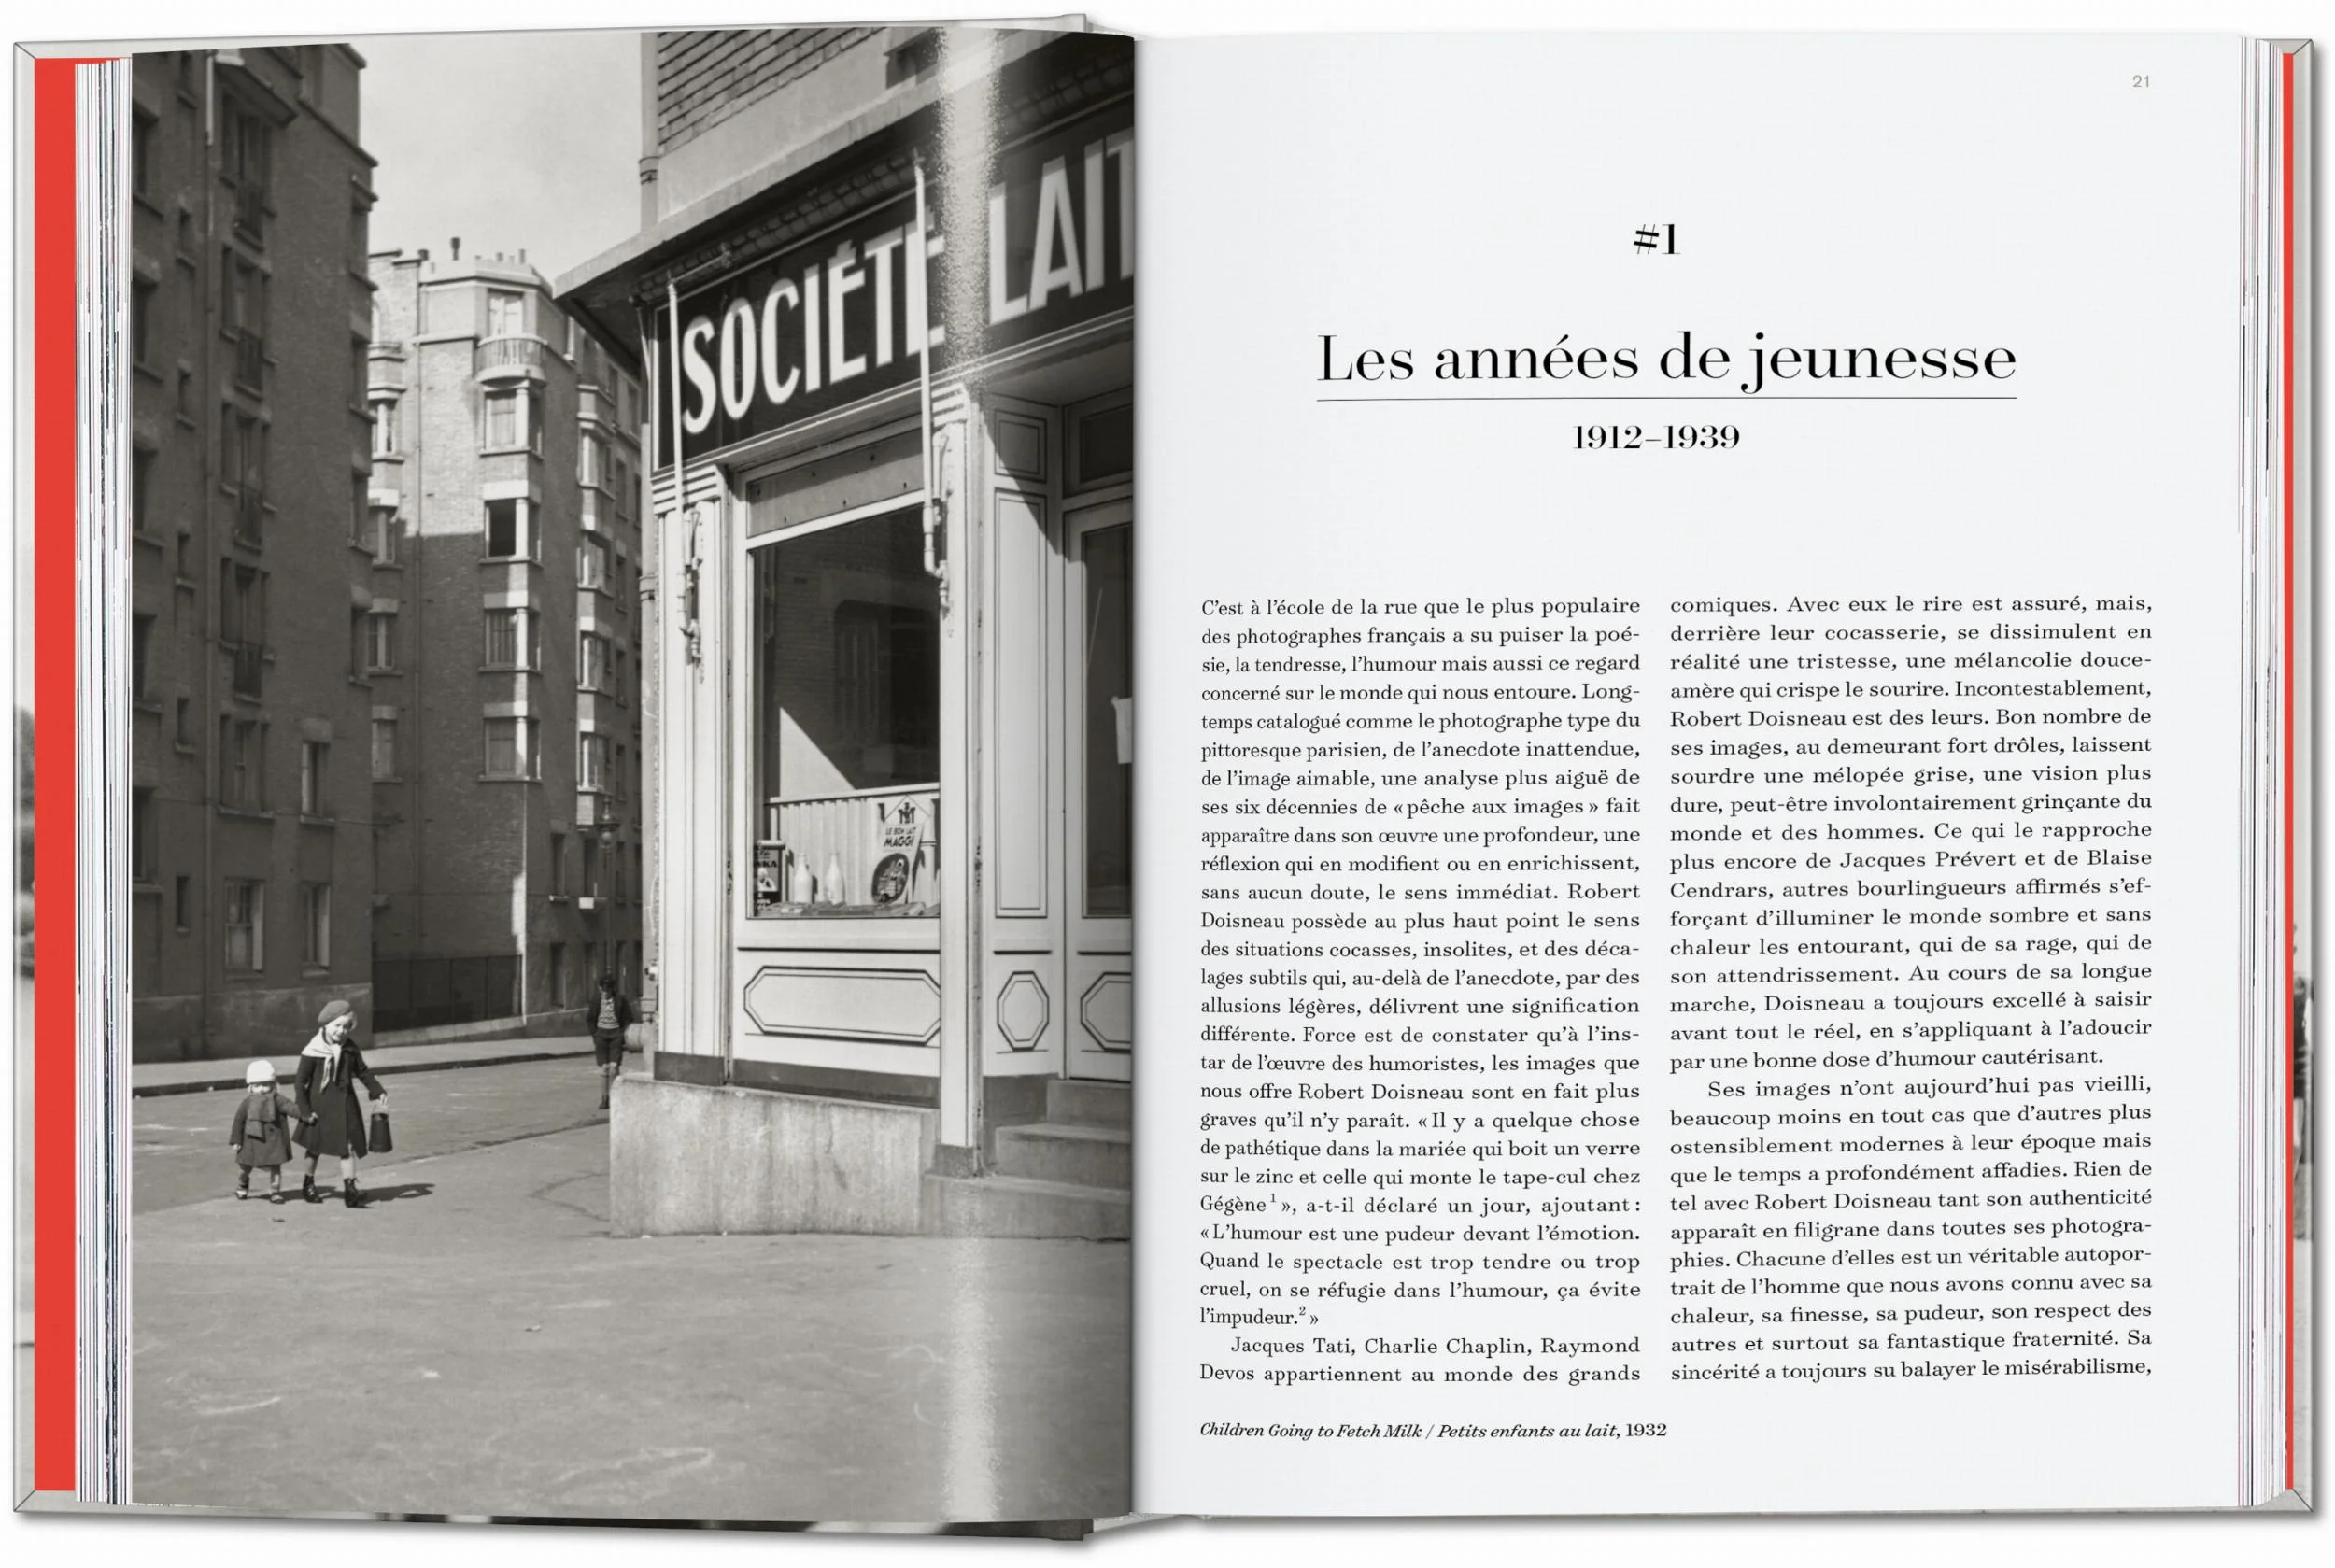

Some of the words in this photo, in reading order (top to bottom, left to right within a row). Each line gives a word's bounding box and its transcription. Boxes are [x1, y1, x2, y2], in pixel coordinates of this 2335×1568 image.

[2132, 74, 2150, 88] 21
[1633, 223, 1681, 255] #1
[682, 208, 947, 434] SOCIÉTÉ
[1316, 334, 1414, 381] Les
[1435, 333, 1639, 380] années
[1659, 330, 1731, 380] de
[1740, 332, 2017, 395] jeunesse
[1201, 600, 1244, 616] C’est
[1251, 599, 1261, 615] à
[1267, 598, 1325, 615] l’école
[1331, 598, 1354, 615] de
[1360, 598, 1379, 614] la
[1384, 602, 1418, 614] rue
[1423, 602, 1460, 619] que
[1465, 597, 1485, 614] le
[1491, 597, 1534, 619] plus
[1541, 596, 1641, 619] populaire
[1670, 596, 1778, 617] comiques.
[1786, 595, 1840, 613] Avec
[1848, 600, 1888, 612] eux
[1895, 595, 1915, 612] le
[1922, 595, 1963, 612] rire
[1972, 597, 2003, 612] est
[2011, 594, 2087, 614] assuré,
[2095, 594, 2152, 614] mais,
[1201, 685, 1281, 701] concerné
[1285, 689, 1315, 701] sur
[1318, 684, 1336, 701] le
[1339, 683, 1404, 700] monde
[1408, 684, 1437, 705] qui
[1442, 688, 1489, 700] nous
[1493, 685, 1577, 700] entoure.
[1581, 683, 1640, 704] Long-
[1670, 682, 1734, 699] amère
[1739, 681, 1772, 703] qui
[1776, 681, 1840, 703] crispe
[1845, 680, 1864, 698] le
[1869, 680, 1949, 698] sourire.
[1955, 679, 2152, 699] Incontestablement,
[1670, 767, 1755, 784] sourdre
[1763, 771, 1804, 784] une
[1812, 766, 1904, 788] mélopée
[1913, 765, 1974, 787] grise,
[1982, 770, 2023, 782] une
[2031, 764, 2099, 782] vision
[2106, 763, 2152, 786] plus
[884, 836, 914, 847] MAGGI
[1670, 824, 1742, 841] monde
[1751, 826, 1773, 841] et
[1781, 823, 1818, 841] des
[1826, 823, 1925, 840] hommes.
[1934, 822, 1962, 839] Ce
[1971, 822, 2005, 843] qui
[2014, 821, 2033, 838] le
[2042, 820, 2152, 842] rapproche
[1200, 855, 1281, 872] réflexion
[1284, 855, 1314, 877] qui
[1319, 860, 1343, 872] en
[1348, 855, 1441, 872] modifient
[1447, 859, 1472, 872] ou
[1477, 859, 1502, 871] en
[1507, 854, 1640, 873] enrichissent,
[1200, 911, 1285, 929] Doisneau
[1291, 911, 1367, 934] possède
[1374, 917, 1397, 929] au
[1404, 911, 1445, 934] plus
[1452, 911, 1499, 929] haut
[1506, 911, 1560, 934] point
[1567, 911, 1586, 928] le
[1593, 916, 1640, 928] sens
[1670, 910, 1748, 931] forçant
[1756, 909, 1875, 926] d’illuminer
[1882, 908, 1902, 925] le
[1909, 907, 1982, 925] monde
[1989, 906, 2069, 924] sombre
[2076, 908, 2098, 923] et
[2106, 910, 2152, 922] sans
[1200, 996, 1281, 1014] allusions
[1288, 997, 1362, 1020] légères,
[1368, 997, 1460, 1015] délivrent
[1465, 1002, 1504, 1014] une
[1511, 996, 1640, 1019] signification
[1669, 995, 1756, 1014] marche,
[1763, 995, 1865, 1011] Doisneau
[1873, 998, 1886, 1010] a
[1893, 993, 1984, 1014] toujours
[1992, 991, 2067, 1009] excellé
[2073, 991, 2087, 1008] à
[2094, 990, 2153, 1007] saisir
[1200, 1086, 1243, 1099] nous
[1249, 1082, 1293, 1099] offre
[1298, 1082, 1365, 1100] Robert
[1371, 1083, 1465, 1100] Doisneau
[1471, 1085, 1515, 1100] sont
[1521, 1087, 1548, 1100] en
[1553, 1082, 1589, 1099] fait
[1594, 1081, 1640, 1104] plus
[1708, 1081, 1746, 1097] Ses
[1755, 1081, 1831, 1102] images
[1839, 1079, 1895, 1095] n’ont
[1904, 1076, 2030, 1099] aujourd’hui
[2037, 1081, 2074, 1098] pas
[2084, 1074, 2152, 1095] vieilli,
[1199, 1251, 1260, 1271] Quand
[1267, 1251, 1284, 1269] le
[1293, 1252, 1383, 1275] spectacle
[1392, 1256, 1422, 1270] est
[1430, 1256, 1474, 1275] trop
[1482, 1252, 1551, 1270] tendre
[1560, 1258, 1587, 1269] ou
[1595, 1255, 1641, 1274] trop
[1669, 1250, 1731, 1274] phies.
[1736, 1250, 1826, 1267] Chacune
[1831, 1249, 1895, 1266] d’elles
[1901, 1250, 1932, 1264] est
[1935, 1252, 1963, 1264] un
[1967, 1246, 2059, 1264] véritable
[2064, 1248, 2152, 1266] autopor-
[1230, 1336, 1305, 1359] Jacques
[1312, 1337, 1356, 1357] Tati,
[1364, 1337, 1438, 1354] Charlie
[1446, 1337, 1533, 1359] Chaplin,
[1540, 1335, 1641, 1359] Raymond
[1671, 1363, 1760, 1380] sincérité
[1765, 1367, 1777, 1379] a
[1781, 1363, 1867, 1384] toujours
[1873, 1366, 1897, 1377] su
[1900, 1360, 1977, 1381] balayer
[1981, 1359, 2000, 1376] le
[2004, 1357, 2152, 1377] misérabilisme,
[1199, 1421, 1265, 1437] Children
[1268, 1423, 1314, 1442] Going
[1317, 1425, 1335, 1438] to
[1336, 1423, 1381, 1438] Fetch
[1382, 1423, 1423, 1438] Milk
[1425, 1424, 1435, 1440] /
[1436, 1423, 1488, 1438] Petits
[1490, 1423, 1556, 1438] enfants
[1558, 1427, 1581, 1438] au
[1584, 1422, 1621, 1440] lait,
[1626, 1422, 1667, 1437] 1932
